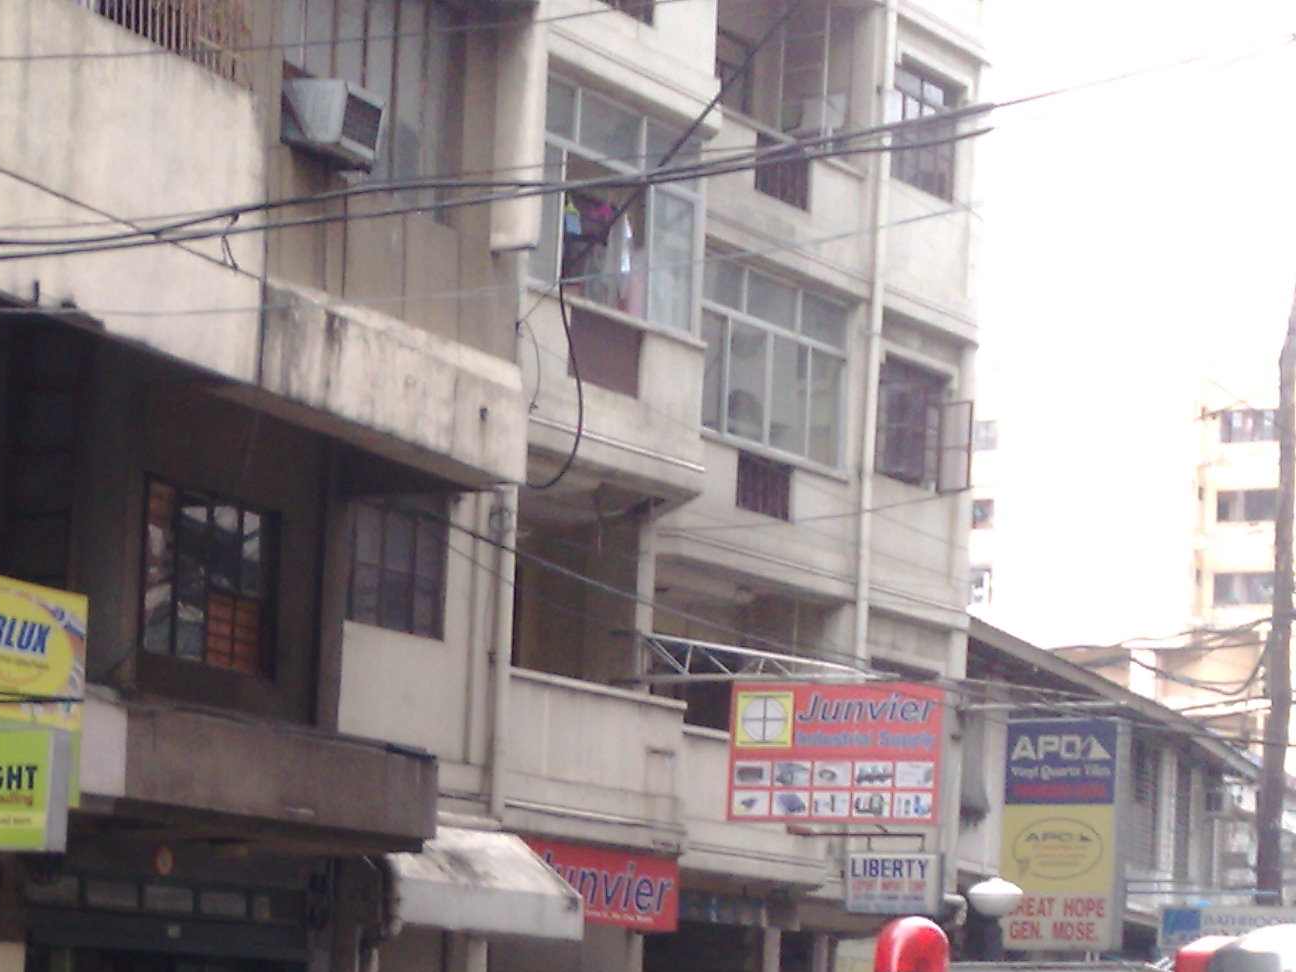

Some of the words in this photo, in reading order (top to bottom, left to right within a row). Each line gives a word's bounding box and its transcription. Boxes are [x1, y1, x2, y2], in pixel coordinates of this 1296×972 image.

[796, 692, 938, 724] Junvier
[851, 858, 928, 878] LIBERTY
[545, 851, 674, 916] nvier
[1008, 897, 1054, 917] REAT
[1064, 897, 1105, 918] HOPE
